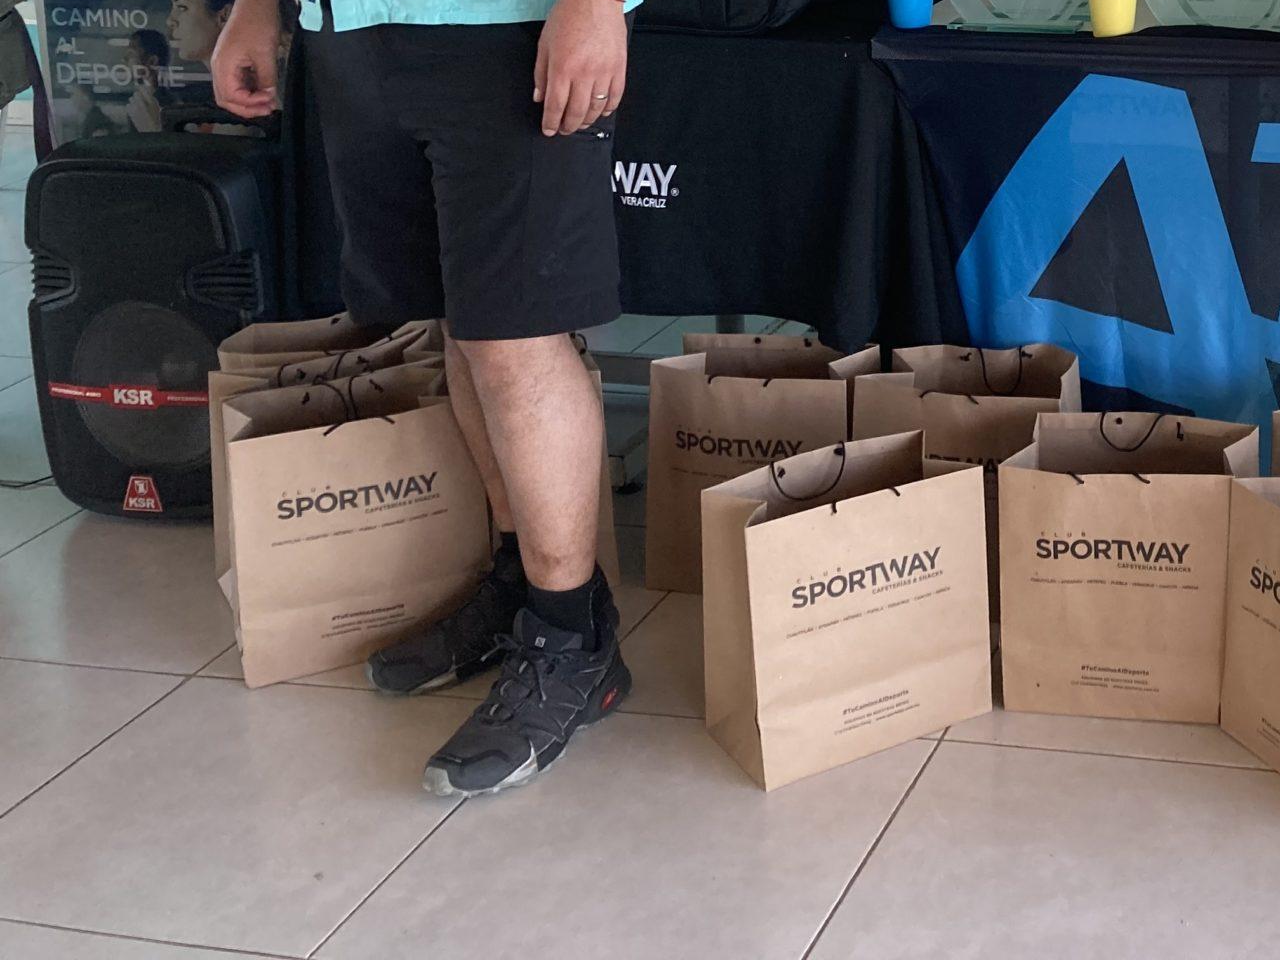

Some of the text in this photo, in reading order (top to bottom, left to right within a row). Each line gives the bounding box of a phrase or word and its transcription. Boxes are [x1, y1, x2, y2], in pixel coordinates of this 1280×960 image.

[51, 7, 148, 28] CAMINO
[56, 37, 85, 55] AL
[620, 196, 667, 208] VERACRUZ
[113, 389, 154, 406] KSR
[676, 430, 802, 458] SPORTWAY
[129, 497, 155, 509] KSR
[277, 472, 438, 520] SPORTWAY
[1036, 538, 1190, 564] SPORTWAY
[791, 546, 941, 609] SPORTWAY
